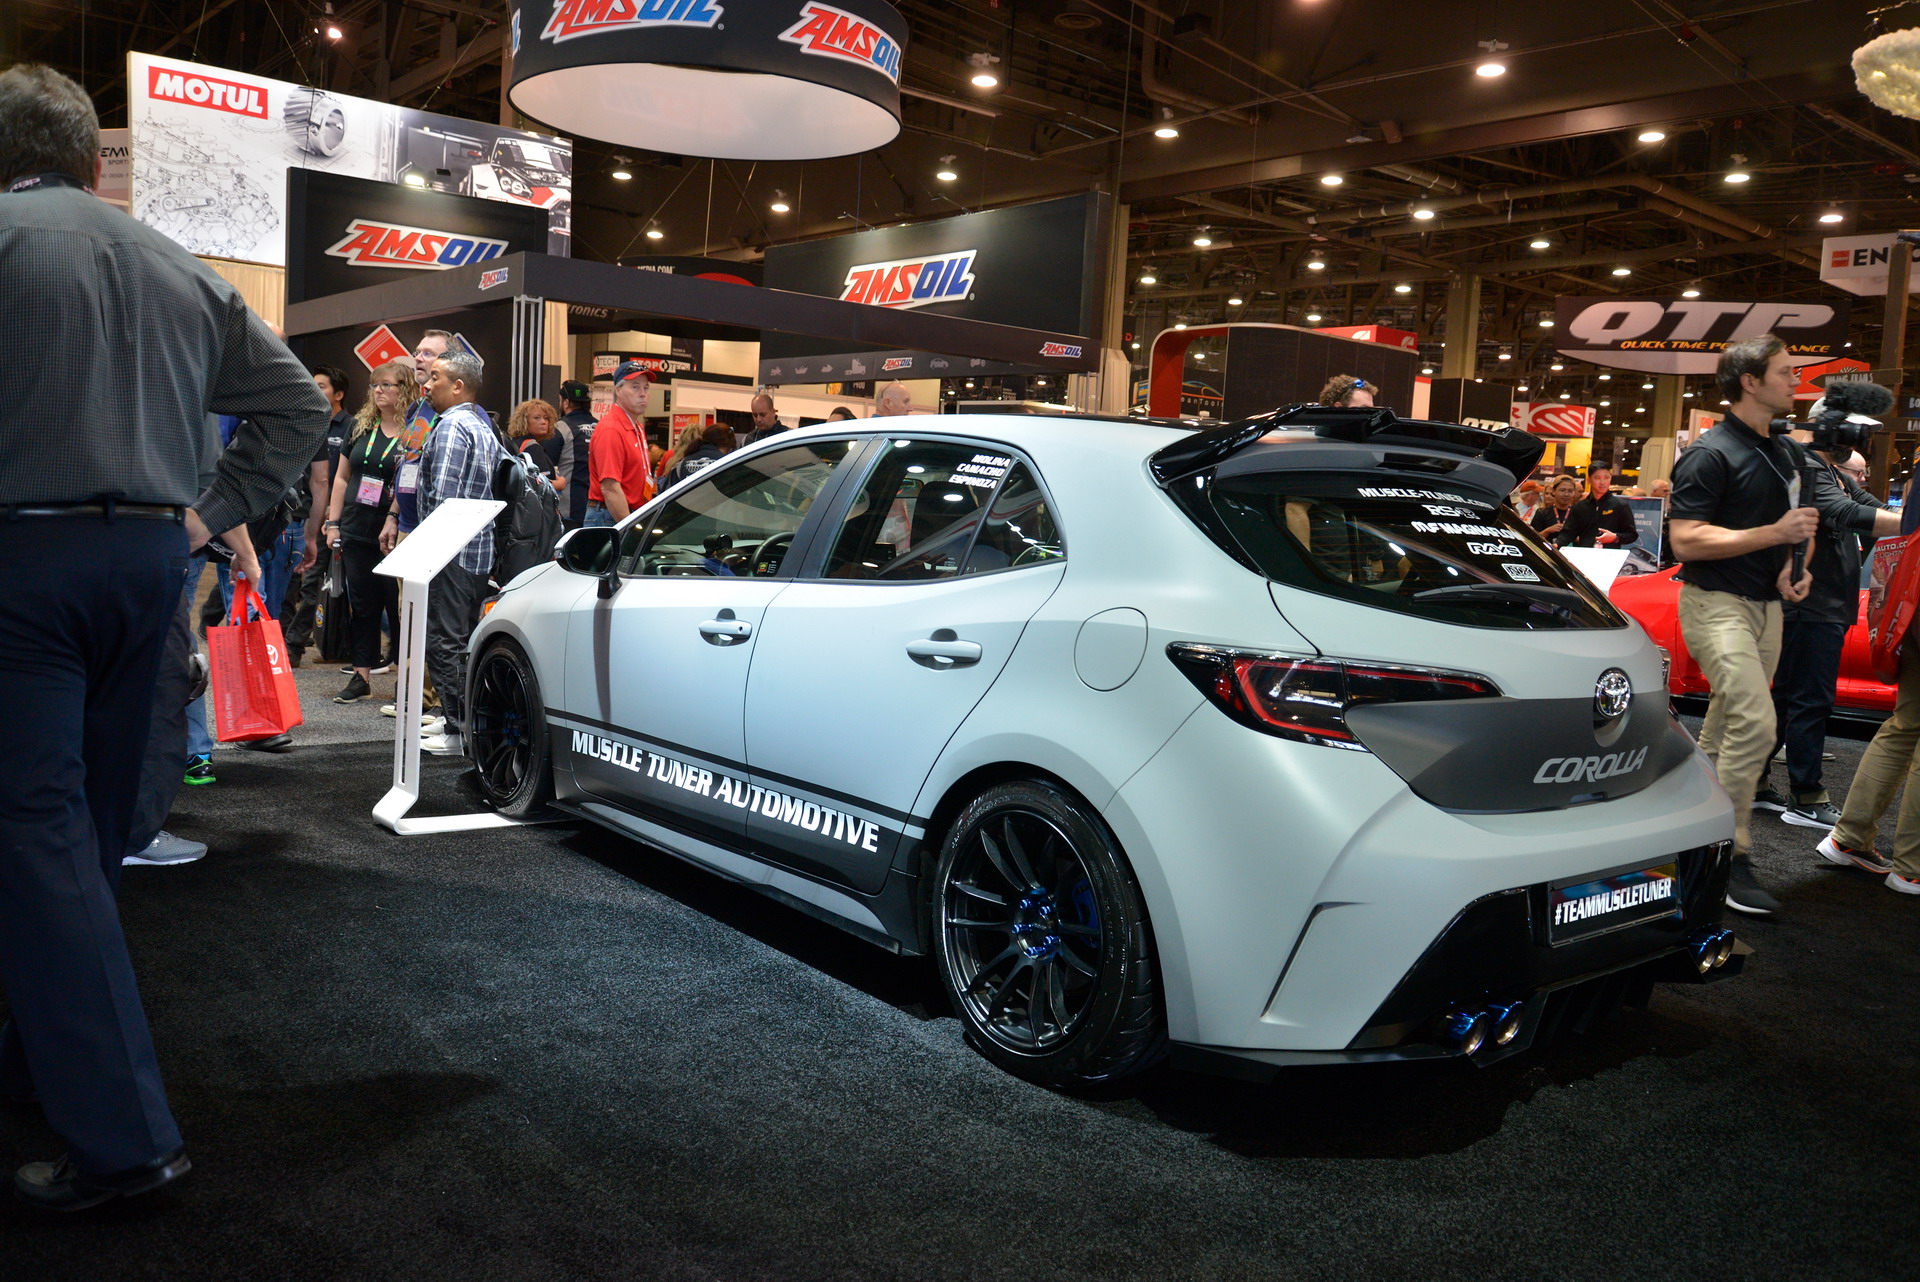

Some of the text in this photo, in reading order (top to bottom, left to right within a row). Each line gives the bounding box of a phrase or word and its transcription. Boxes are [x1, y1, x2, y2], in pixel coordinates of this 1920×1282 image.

[788, 5, 900, 81] AMSOIL
[153, 72, 264, 114] MOTUL
[480, 268, 508, 290] AMSOIL
[842, 255, 972, 308] AMSOIL
[1569, 301, 1835, 345] QTP
[1041, 342, 1082, 358] AMSOIL
[1620, 341, 1831, 353] QUICK TIME PEANCE
[884, 357, 912, 370] AMSOIL
[956, 462, 1006, 477] CAMACHO
[970, 454, 1011, 468] MOLINA
[948, 474, 998, 489] ESPINOZA
[1466, 542, 1523, 557] RAYS
[1533, 745, 1649, 784] COROLLA
[571, 730, 880, 853] MUSCLE TUNER AUTOMOTIVE
[1555, 877, 1672, 926] #TEAMMUSCLETUNER
